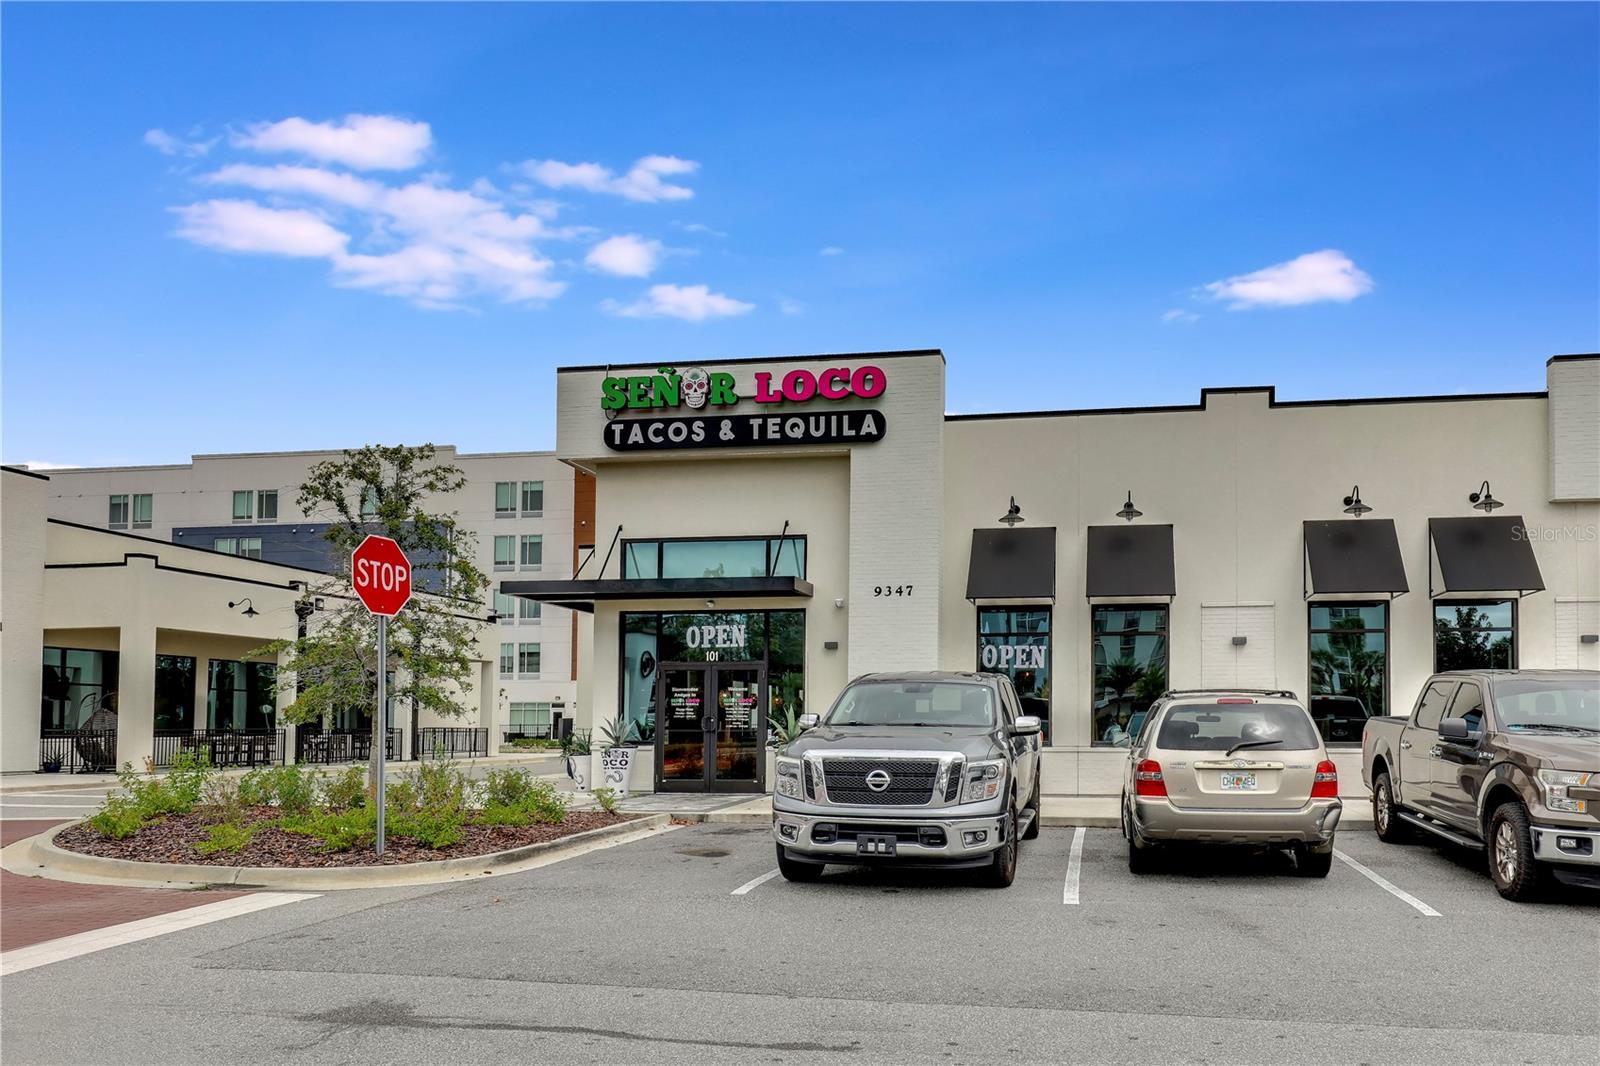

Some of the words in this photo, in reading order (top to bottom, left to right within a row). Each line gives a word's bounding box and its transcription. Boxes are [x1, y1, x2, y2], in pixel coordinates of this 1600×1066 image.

[754, 365, 887, 404] LOCO
[611, 420, 706, 445] TACOS
[718, 419, 735, 441] &
[749, 413, 878, 440] TEQUILA
[356, 558, 407, 592] STOP
[873, 585, 913, 597] 9347
[686, 624, 746, 648] OPEN
[705, 651, 719, 662] 101
[982, 644, 1047, 669] OPEN
[602, 759, 629, 767] OCO
